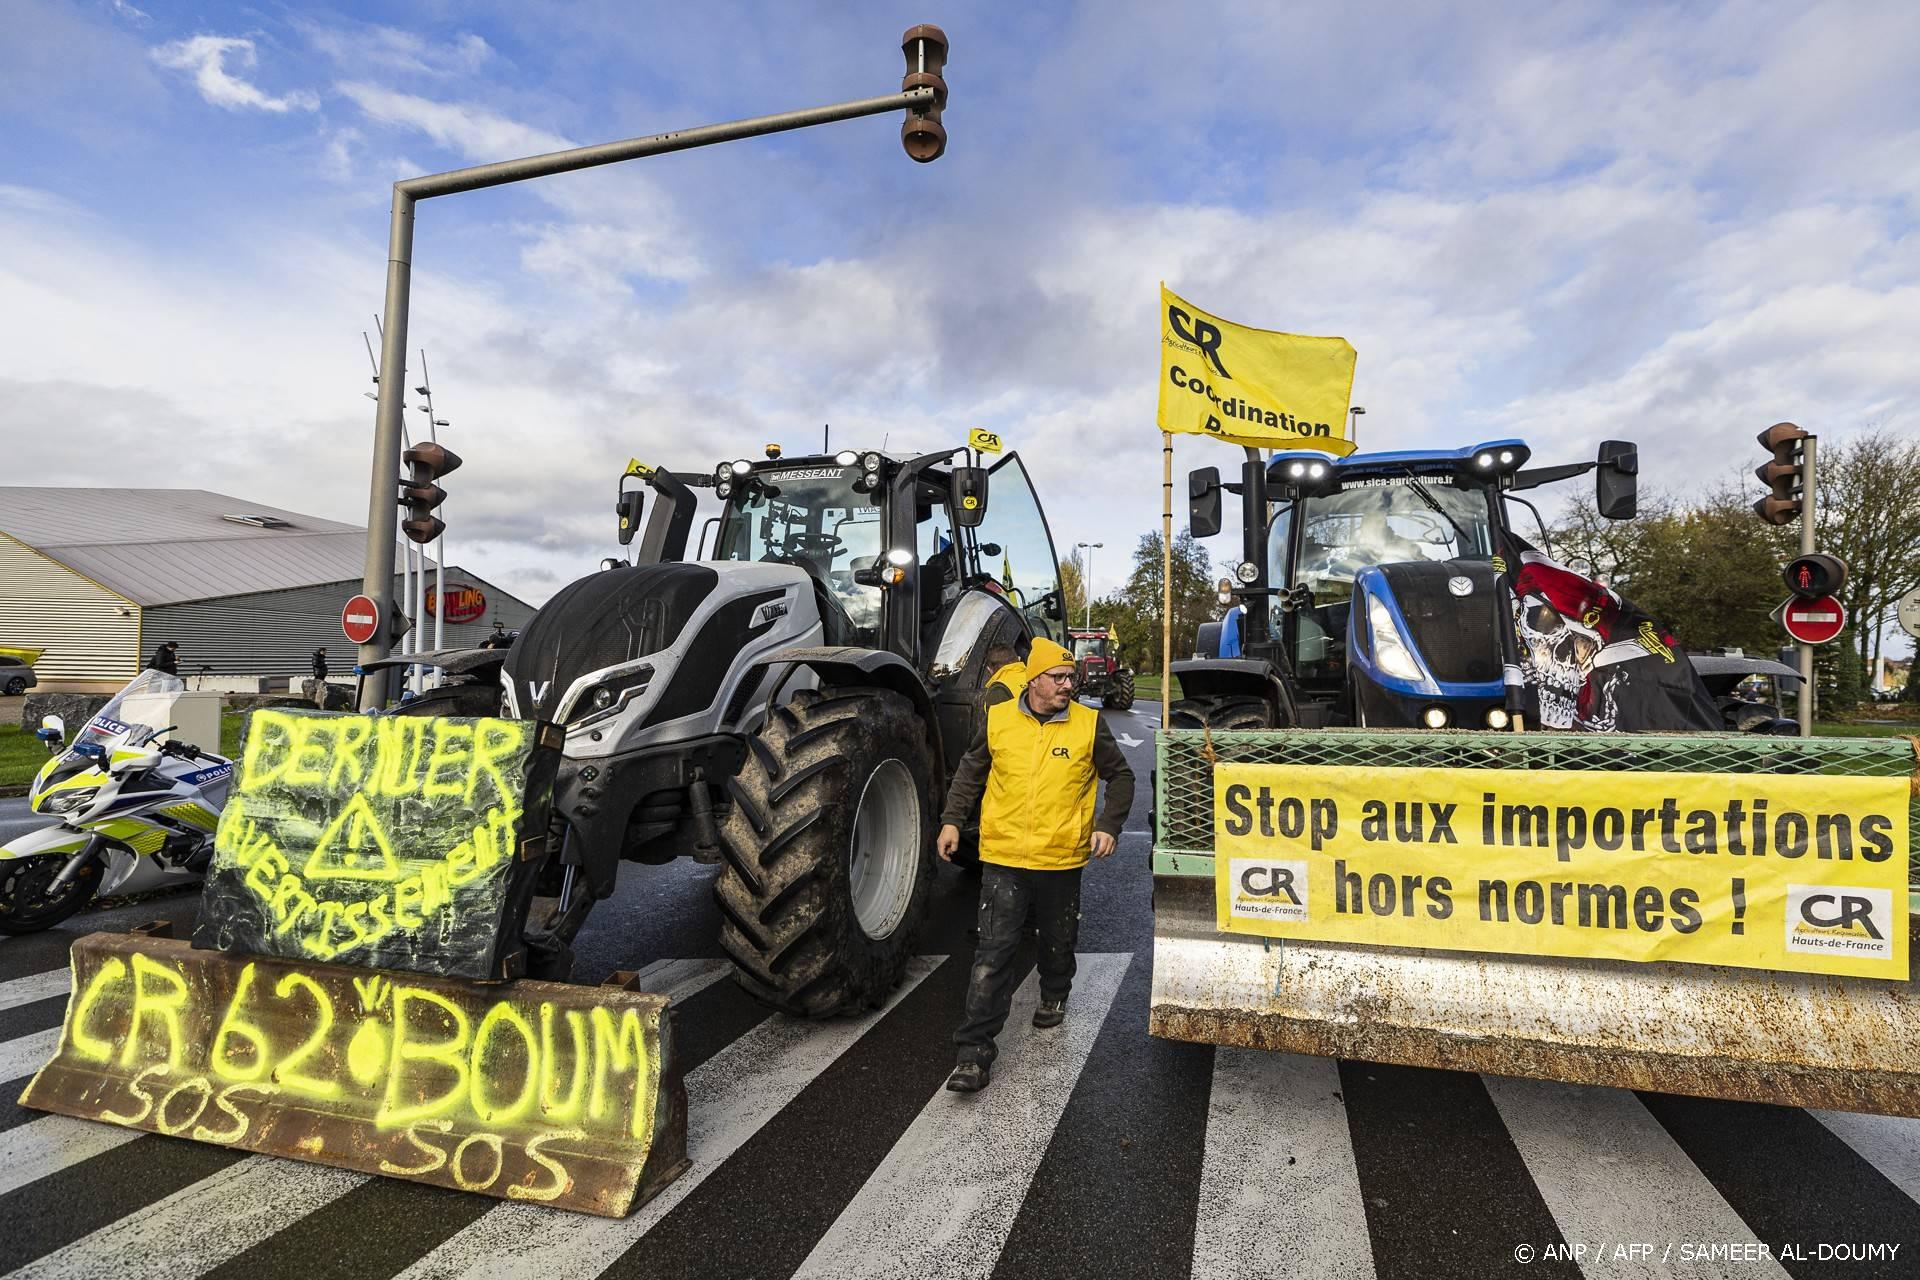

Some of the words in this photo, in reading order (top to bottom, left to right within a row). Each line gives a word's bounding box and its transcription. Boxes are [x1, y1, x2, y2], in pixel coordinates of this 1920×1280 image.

[1169, 305, 1232, 379] CR
[977, 433, 998, 446] CR
[780, 469, 844, 479] MESSEANT
[95, 718, 125, 734] OLICE
[206, 766, 232, 779] POLIC
[240, 709, 522, 806] DERNIER
[1052, 748, 1070, 759] CR
[1225, 784, 1338, 850] Stop
[1361, 799, 1458, 844] aux
[1482, 792, 1894, 863] importations
[1241, 867, 1303, 906] CR
[1335, 859, 1453, 920] hors
[1478, 879, 1704, 935] normes
[1730, 877, 1748, 935] !
[1235, 903, 1303, 915] Hauts-de-France
[1800, 894, 1885, 940] CR
[1791, 935, 1884, 951] Hauts-de-France
[73, 953, 188, 1067] CR
[211, 962, 340, 1096] 62
[375, 985, 649, 1138] BOUM
[100, 1062, 282, 1144] SOS
[378, 1118, 588, 1201] SOS
